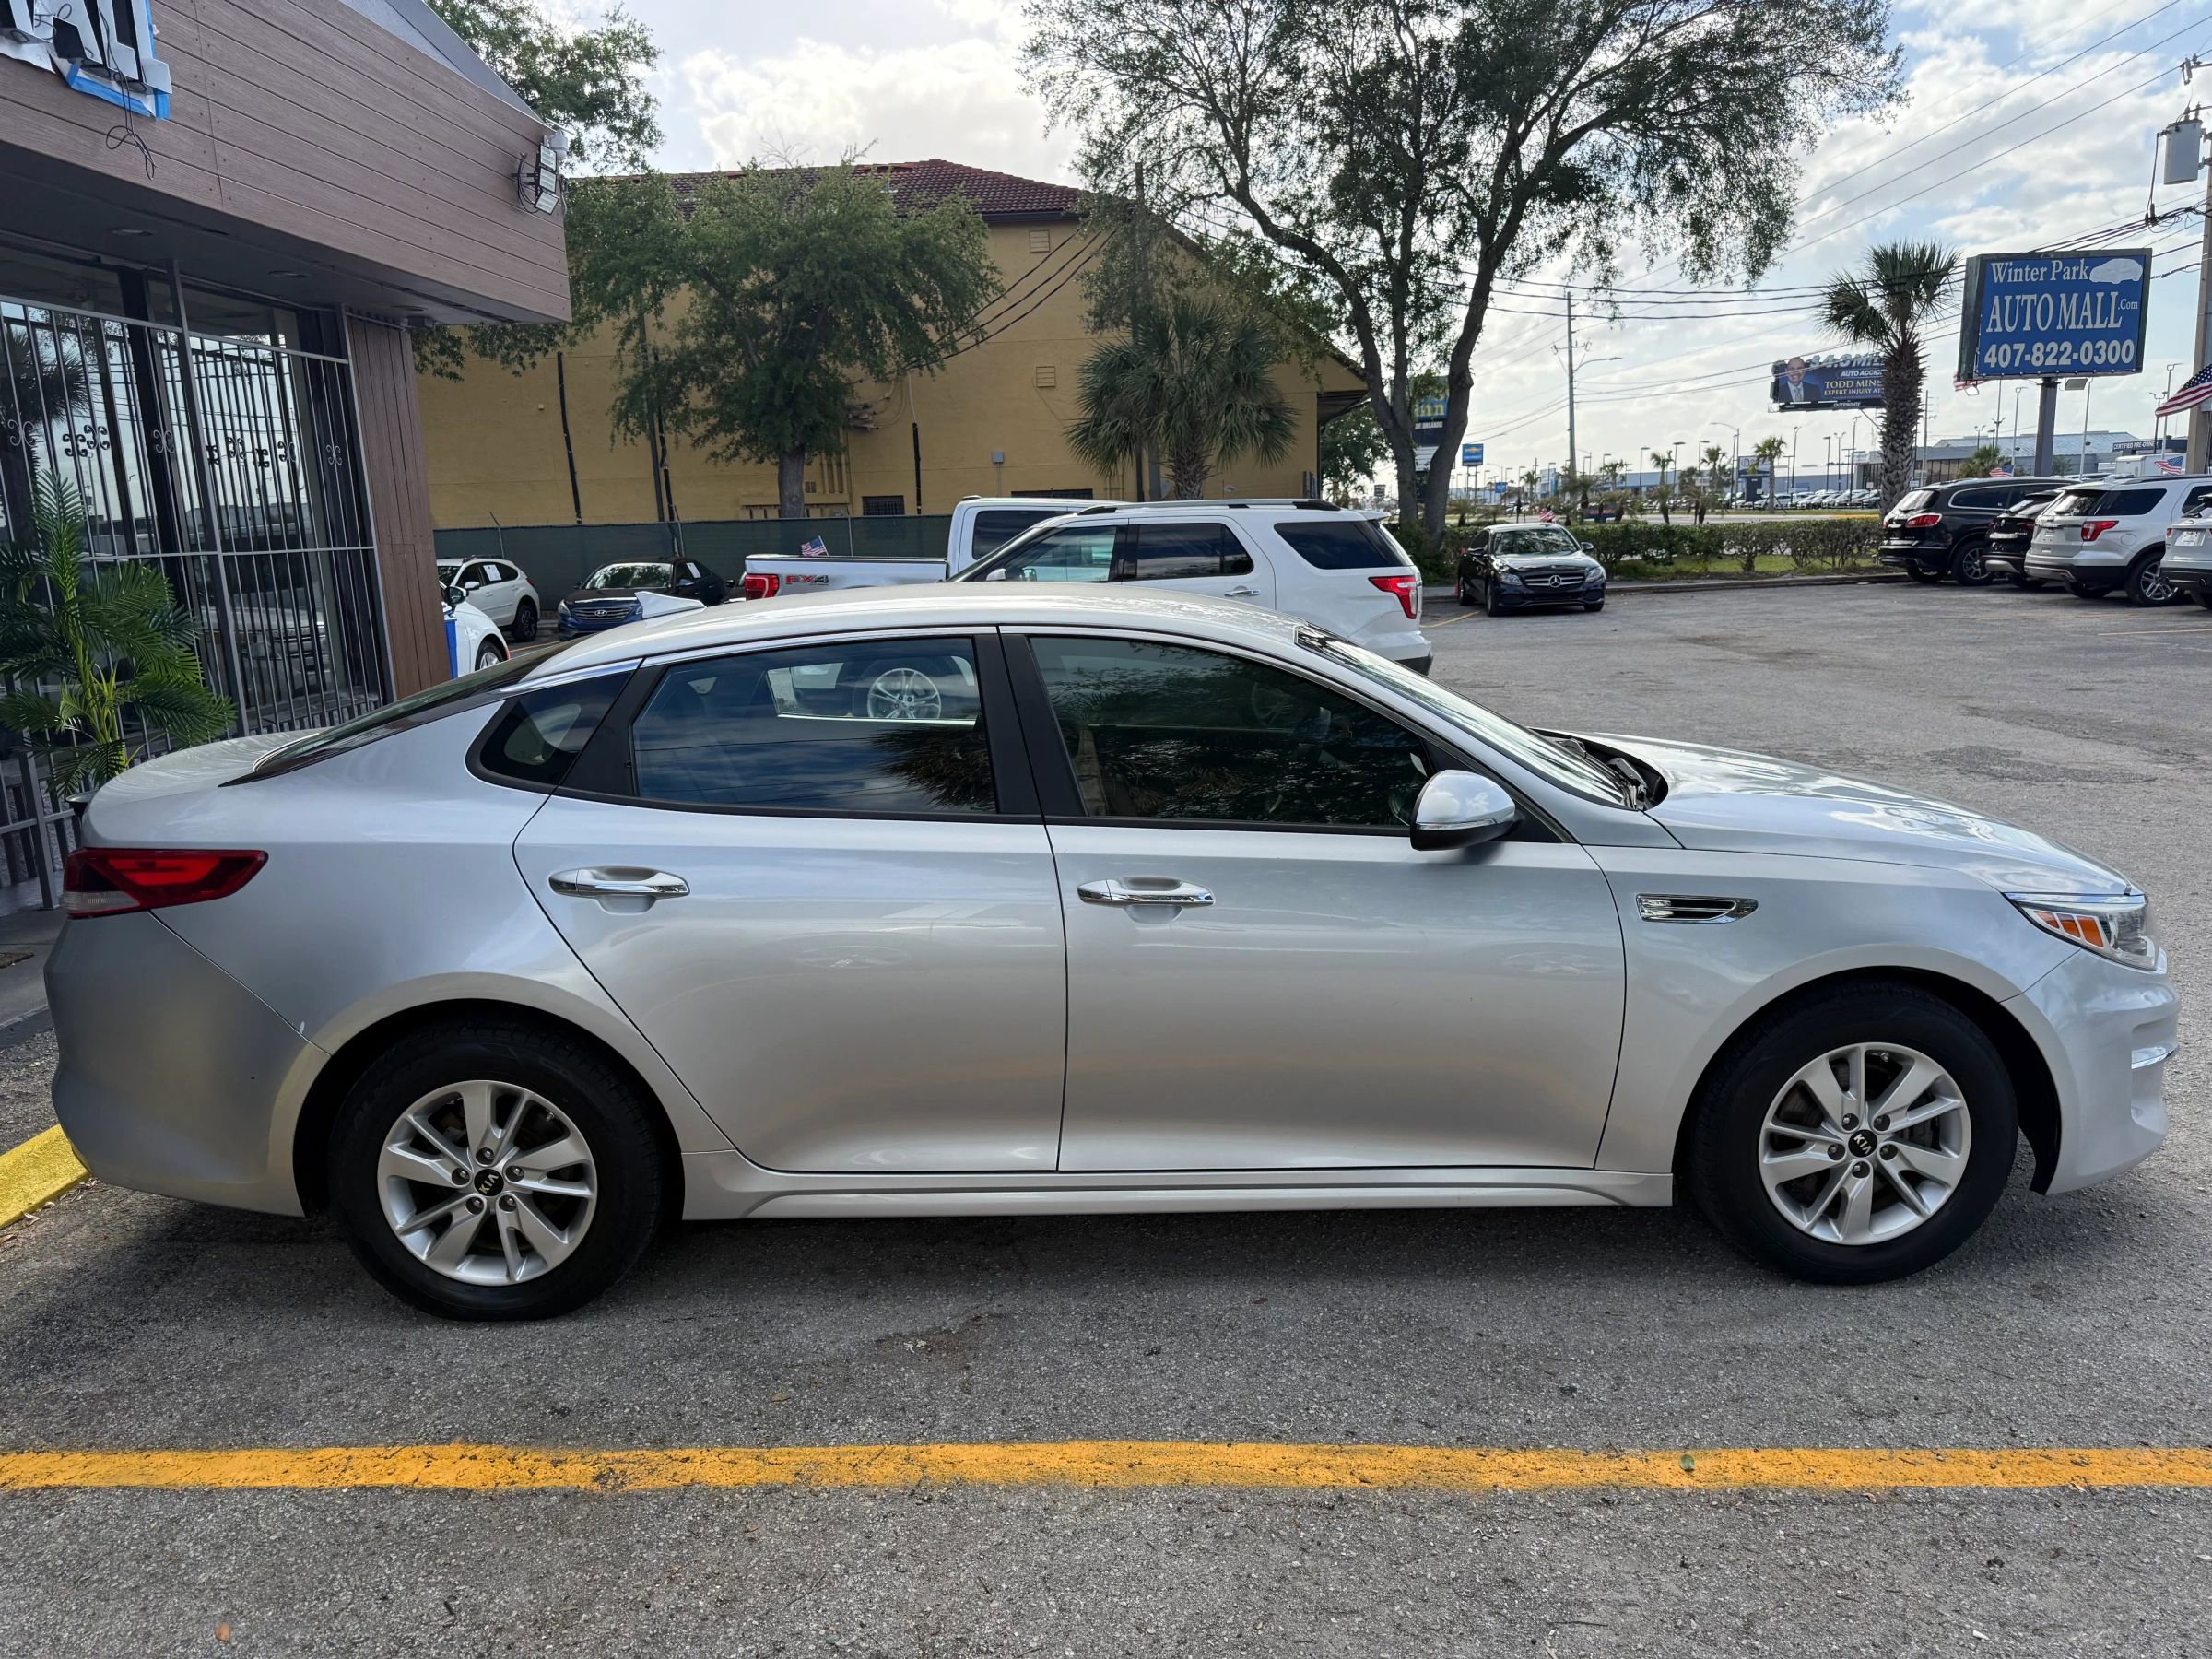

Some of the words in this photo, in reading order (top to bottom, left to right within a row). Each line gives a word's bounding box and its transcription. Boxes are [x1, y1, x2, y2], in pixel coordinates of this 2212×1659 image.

[1991, 261, 2047, 283] Winter
[2050, 258, 2089, 281] Park
[1986, 293, 2053, 333] AUTO
[2056, 291, 2122, 330] MALL
[1984, 339, 2135, 368] 407-822-0300
[1860, 369, 1882, 377] ACCID
[1825, 380, 1853, 389] TODD
[786, 574, 829, 584] FX4
[1853, 1134, 1872, 1155] KIA
[479, 1174, 499, 1194] KIA
